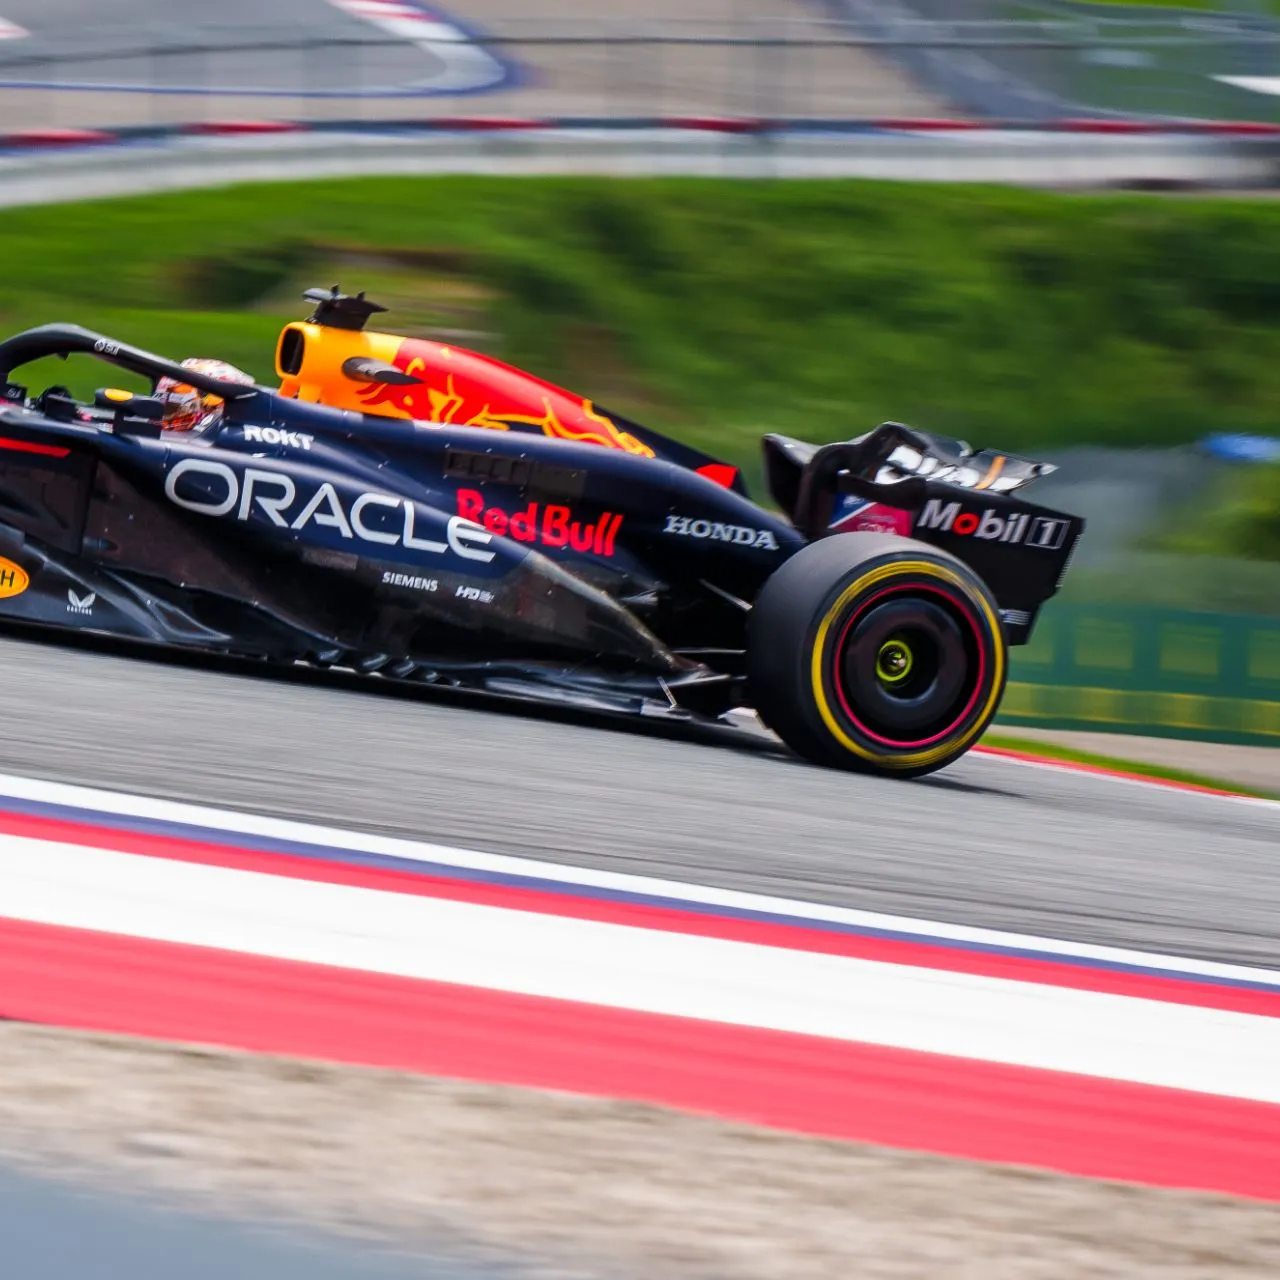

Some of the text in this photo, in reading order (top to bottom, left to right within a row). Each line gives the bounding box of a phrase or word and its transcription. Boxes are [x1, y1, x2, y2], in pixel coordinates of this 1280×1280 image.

[243, 424, 314, 451] ROKT
[165, 458, 496, 562] ORACLE
[456, 488, 624, 557] Red Bull
[917, 499, 1030, 543] Mobil
[663, 515, 780, 551] HONDA
[382, 571, 439, 592] SIEMENS
